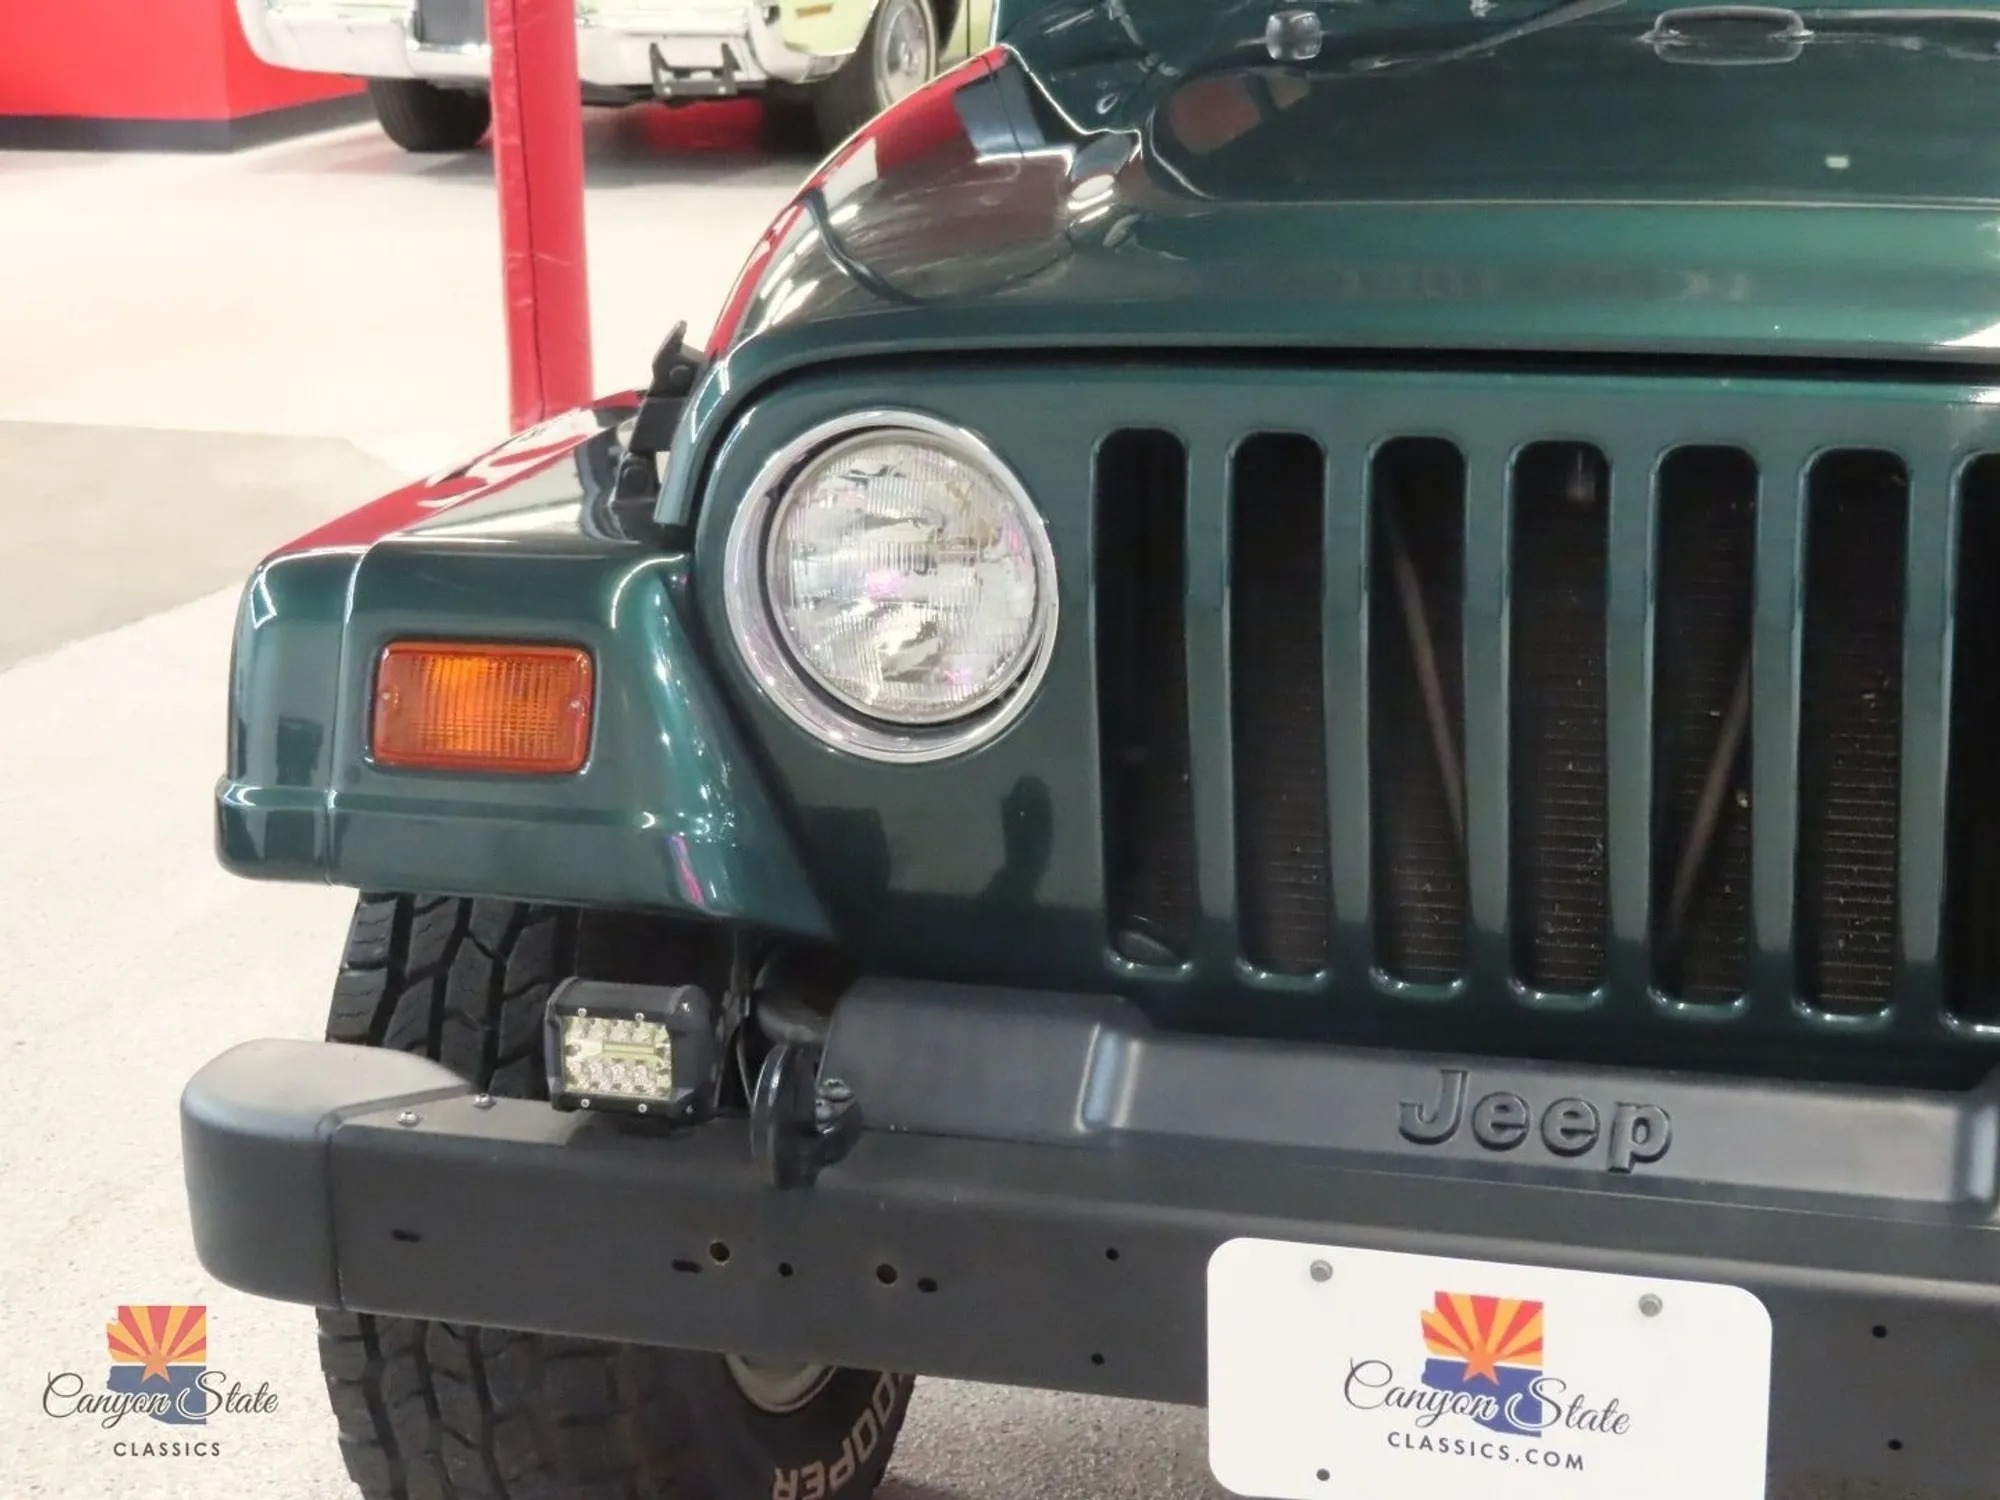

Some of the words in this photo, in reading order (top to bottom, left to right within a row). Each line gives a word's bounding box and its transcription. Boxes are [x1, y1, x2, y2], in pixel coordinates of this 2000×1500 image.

[1399, 1069, 1672, 1174] Jeep
[772, 1371, 904, 1500] OOPER
[1343, 1356, 1500, 1428] Canyon
[1504, 1377, 1632, 1435] State
[1387, 1432, 1585, 1471] CLASSICS.COM
